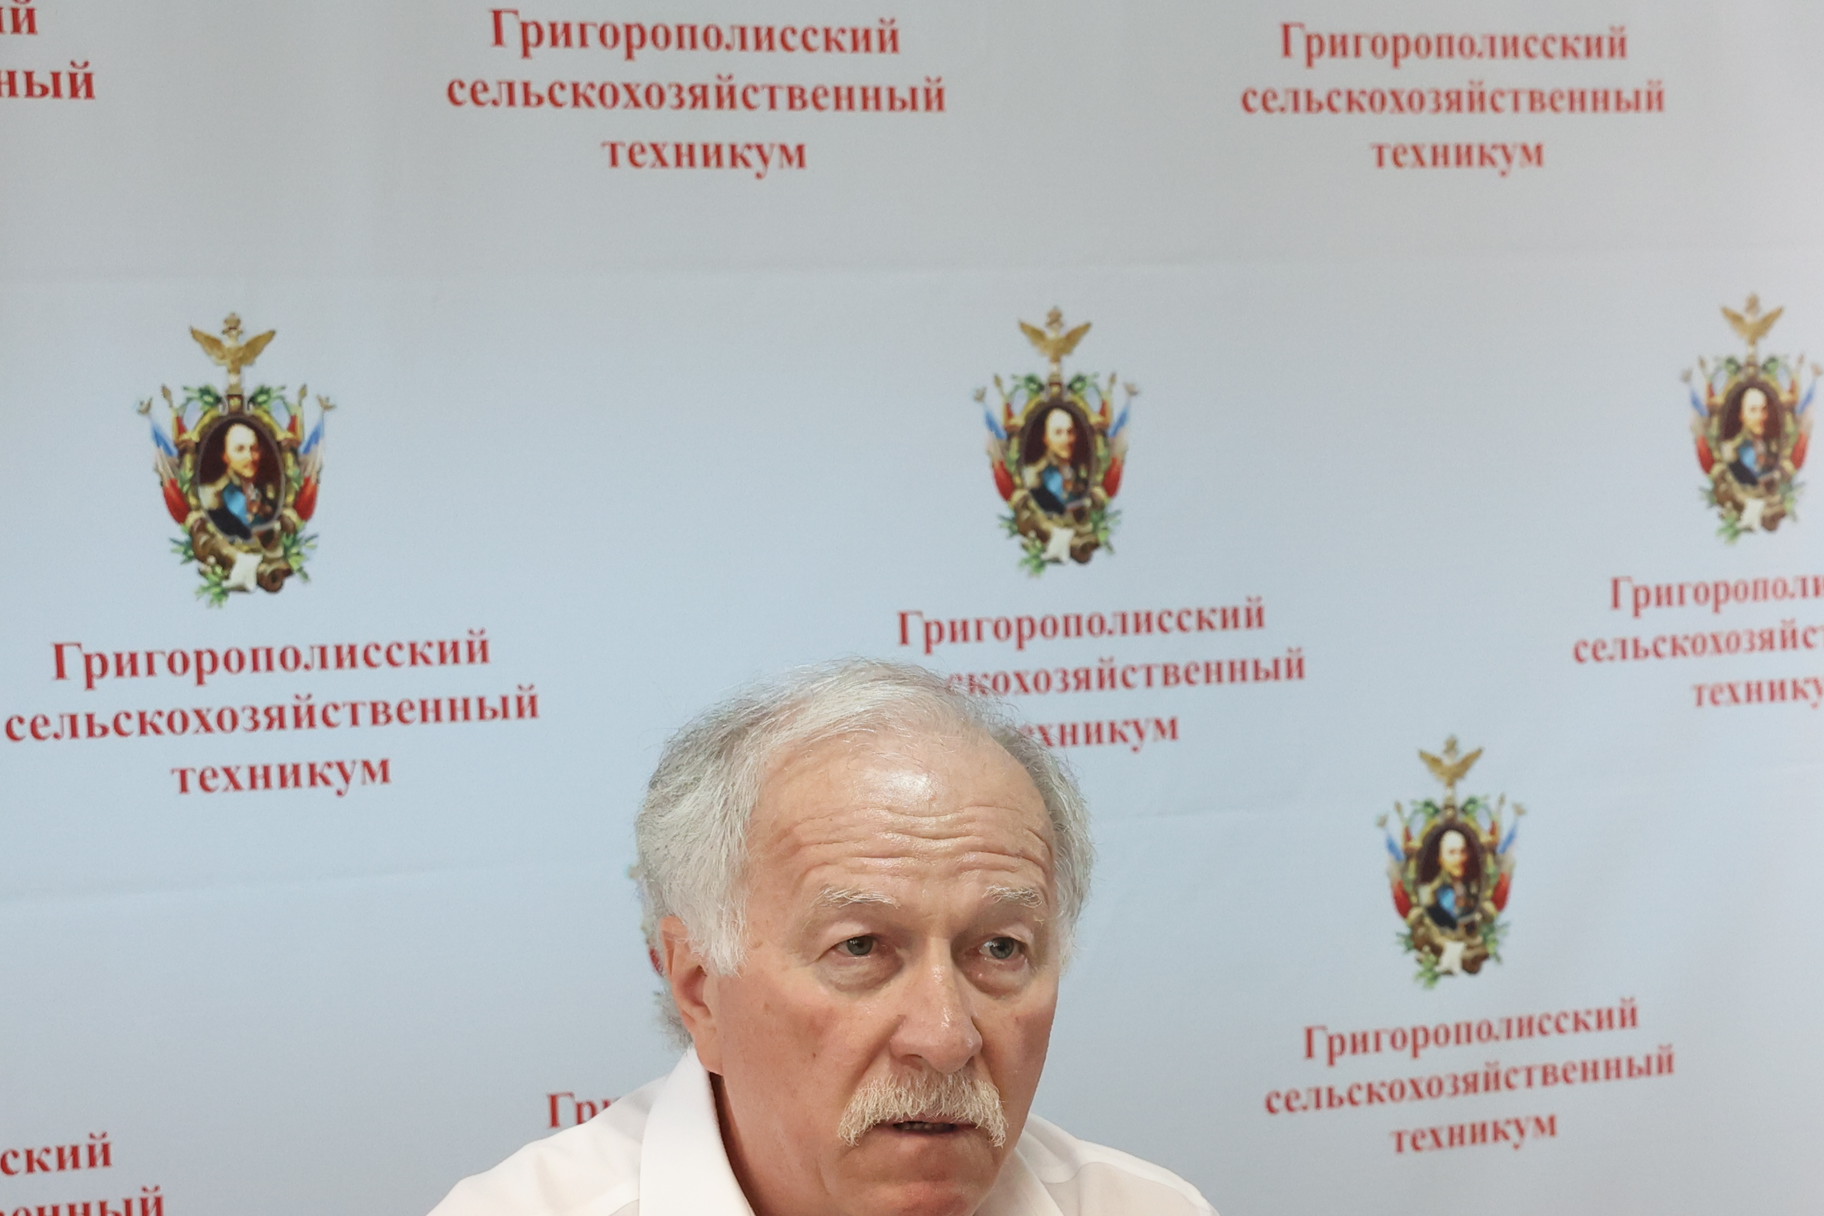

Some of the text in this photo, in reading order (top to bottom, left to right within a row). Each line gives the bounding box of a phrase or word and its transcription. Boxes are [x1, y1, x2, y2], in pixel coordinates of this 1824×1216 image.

[491, 8, 901, 62] Григорополисский
[1280, 22, 1628, 70] Григорополисский
[446, 74, 946, 113] сельскохозяйственный
[1240, 80, 1665, 115] сельскохозяйственный
[601, 136, 807, 180] техникум
[1371, 140, 1545, 177] техникум
[897, 597, 1266, 655] Григорополисский
[52, 630, 491, 691] Григорополисский
[4, 685, 540, 743] сельскохозяйственный
[1020, 716, 1180, 752] хникум
[174, 754, 391, 797] техникум
[1303, 998, 1640, 1067] Григорополисский
[1264, 1045, 1676, 1115] сельскохозяйственный
[1390, 1110, 1558, 1155] техникум
